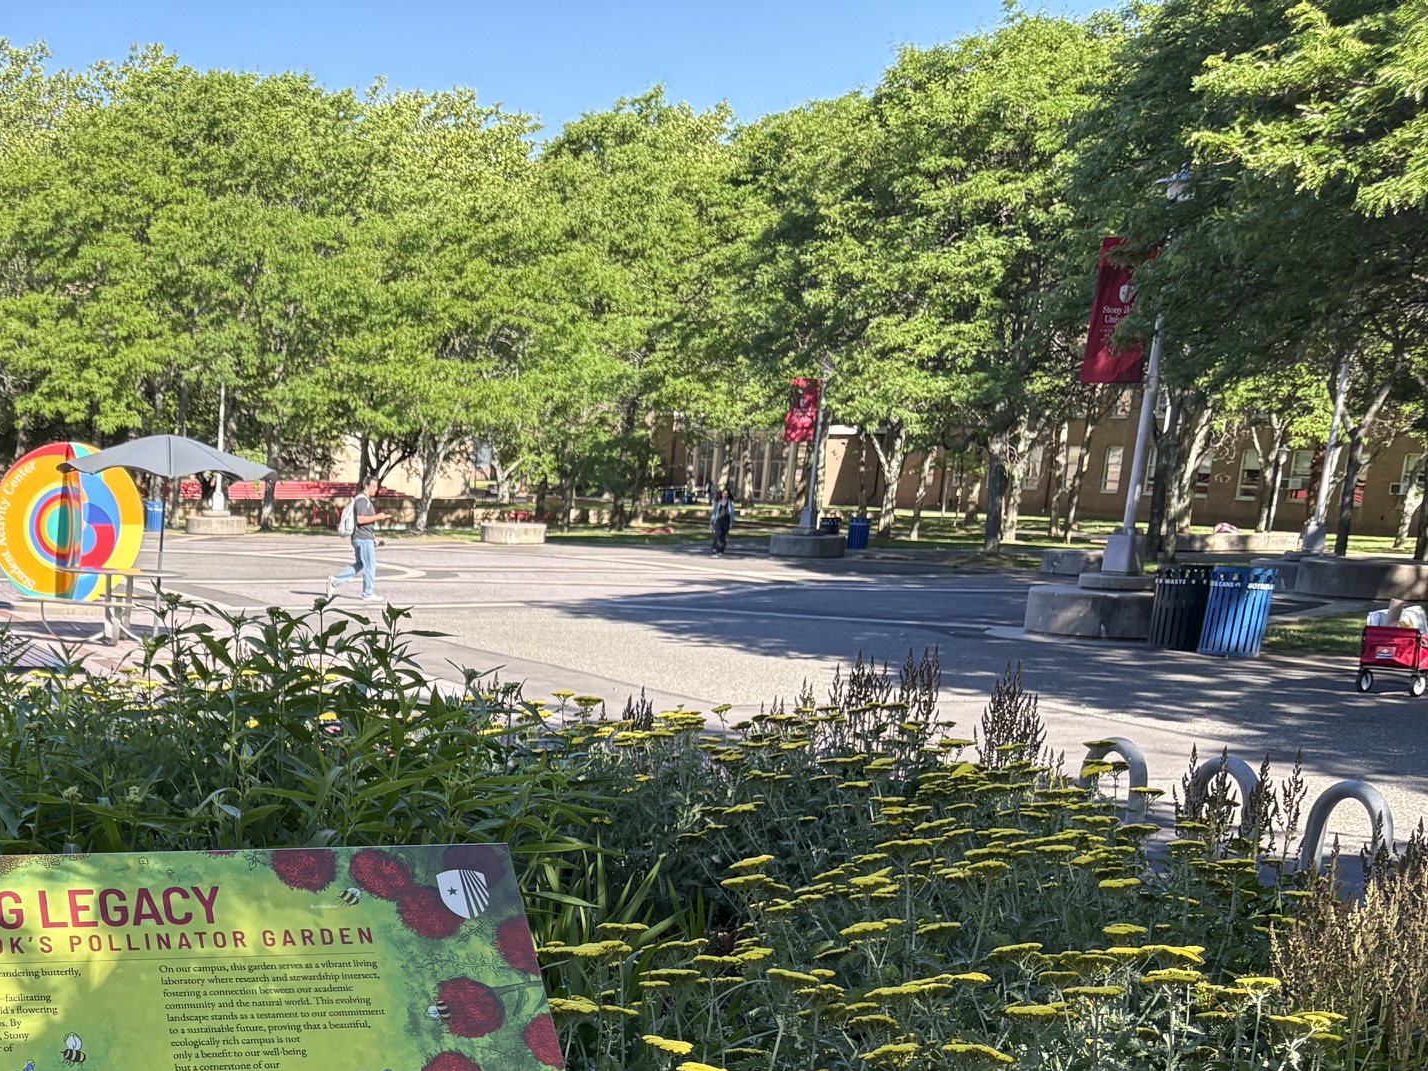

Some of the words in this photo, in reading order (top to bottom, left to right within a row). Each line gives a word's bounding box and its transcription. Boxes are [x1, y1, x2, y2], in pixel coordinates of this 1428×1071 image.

[3, 460, 36, 495] Center
[2, 549, 36, 590] Student
[38, 887, 220, 928] LEGACY
[68, 930, 247, 951] POLLINATOR
[260, 927, 374, 946] GARDEN
[158, 964, 174, 973] On
[192, 965, 229, 974] campus,
[229, 962, 246, 971] this
[246, 961, 277, 973] garden
[320, 959, 352, 968] vibrant
[352, 959, 378, 969] living
[160, 976, 206, 987] laboratory
[207, 975, 233, 984] where
[234, 974, 269, 983] research
[270, 973, 288, 982] and
[288, 972, 340, 983] stewardship
[340, 971, 380, 981] intersect,
[164, 1000, 216, 1012] community
[217, 999, 234, 1008] and
[235, 999, 250, 1007] the
[251, 998, 282, 1007] natural
[283, 997, 312, 1006] world.
[313, 996, 334, 1005] This
[334, 995, 371, 1006] evolving
[166, 1012, 209, 1024] landscape
[210, 1011, 238, 1020] stands
[256, 1010, 298, 1019] testament
[327, 1007, 385, 1017] commitment
[9, 1018, 21, 1029] By
[168, 1026, 178, 1034] to
[186, 1024, 234, 1034] sustainable
[235, 1023, 266, 1033] future,
[267, 1022, 302, 1033] proving
[302, 1021, 321, 1030] that
[328, 1019, 371, 1030] beautiful,
[3, 1030, 29, 1042] Stony
[170, 1037, 221, 1049] ecologically
[221, 1036, 239, 1045] rich
[240, 1037, 275, 1047] campus
[276, 1035, 283, 1043] is
[284, 1035, 301, 1043] not
[2, 1043, 14, 1052] of
[172, 1050, 193, 1061] only
[200, 1049, 232, 1058] benefit
[232, 1049, 243, 1057] to
[261, 1046, 307, 1058] well-being
[174, 1063, 191, 1071] but
[198, 1062, 251, 1071] cornerstone
[252, 1060, 263, 1069] of
